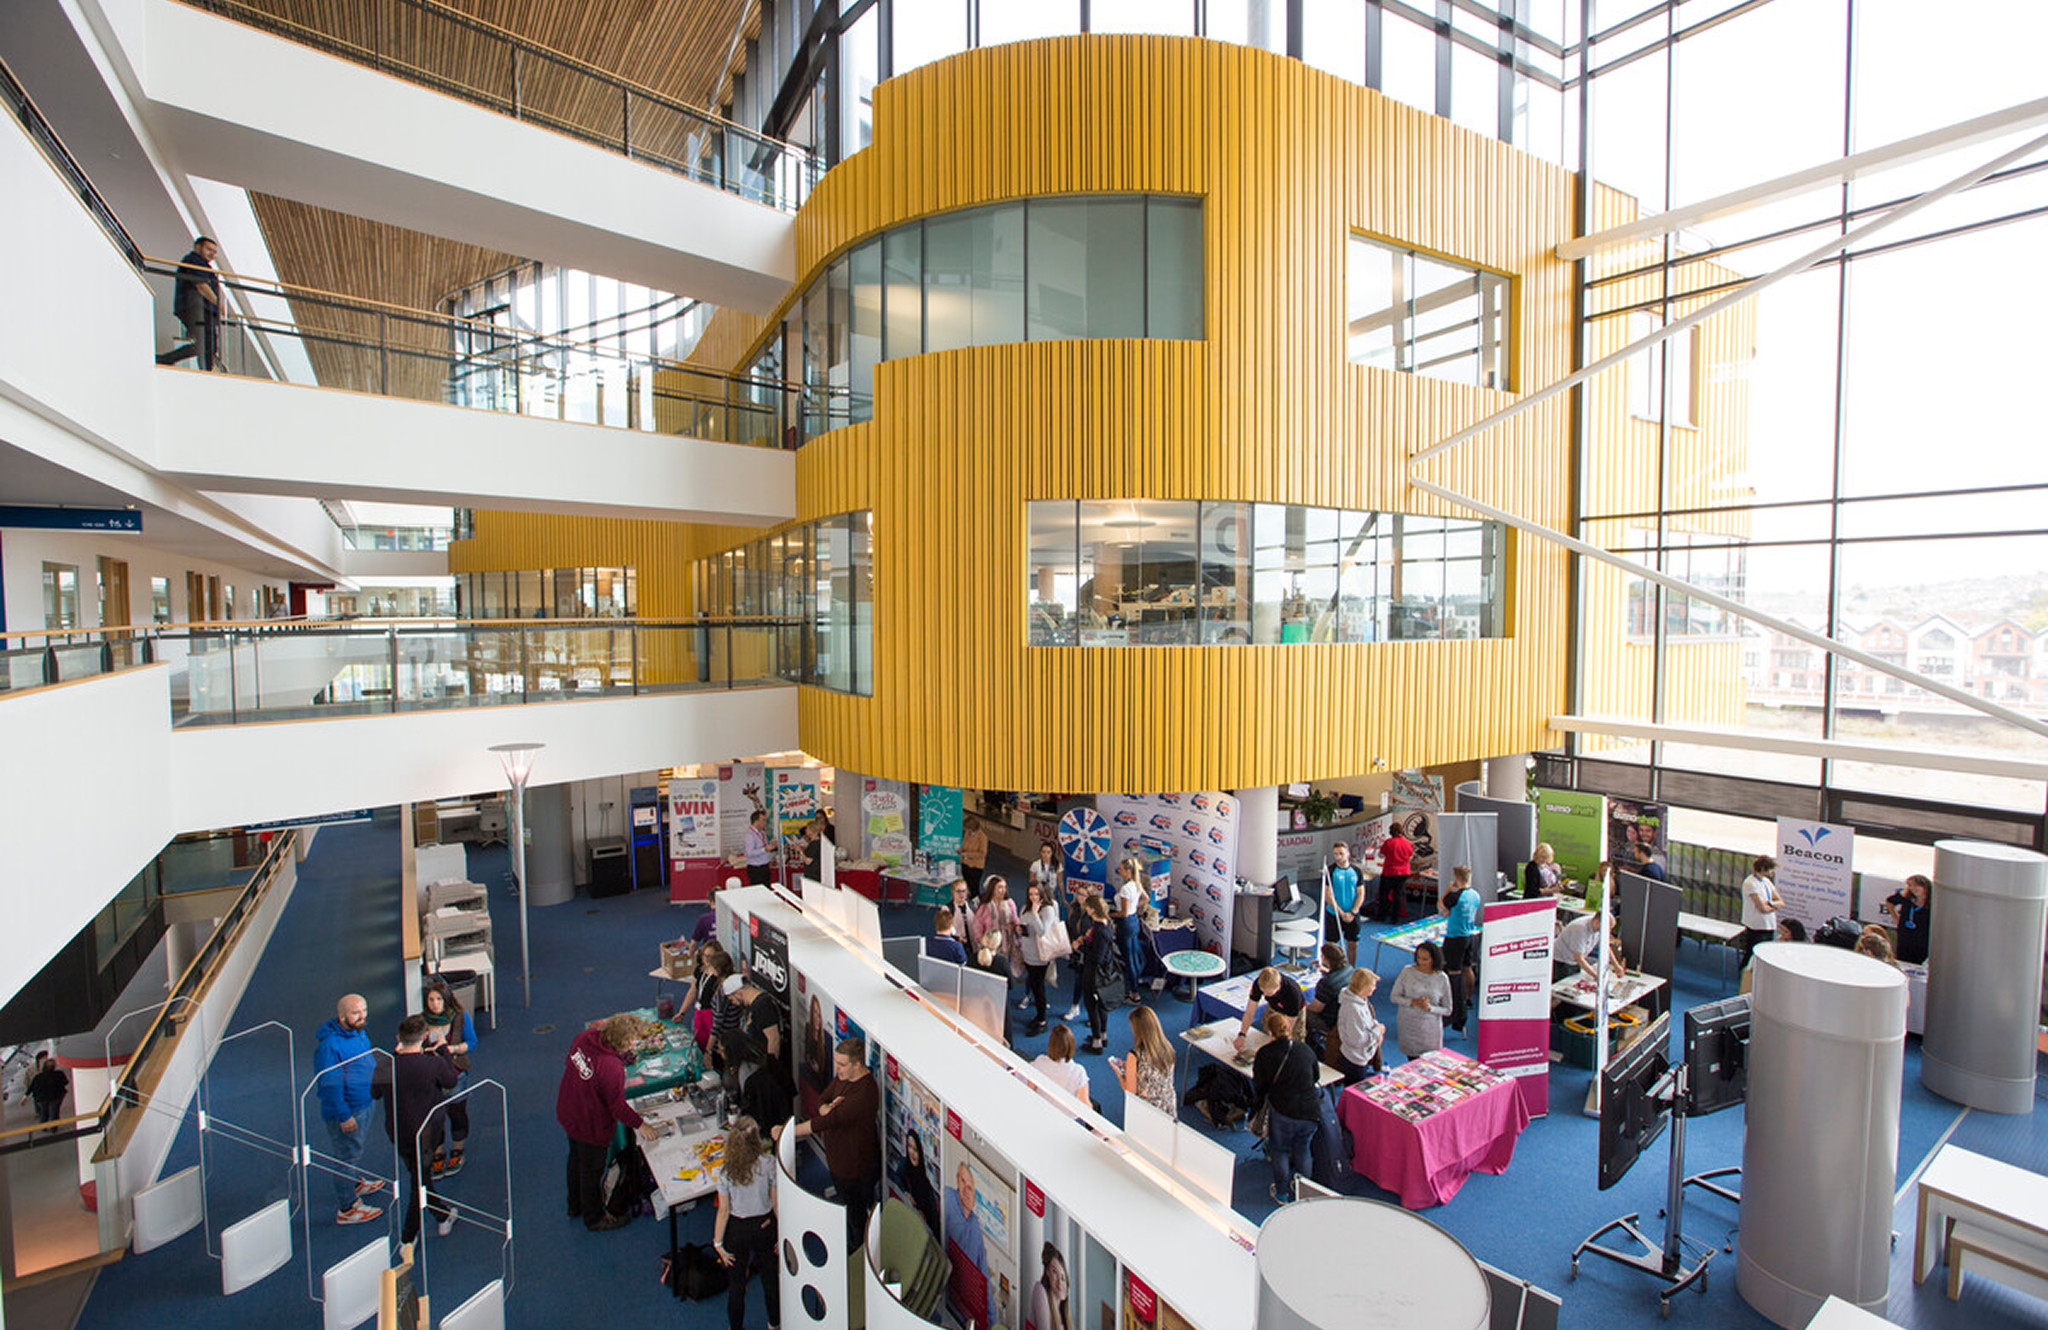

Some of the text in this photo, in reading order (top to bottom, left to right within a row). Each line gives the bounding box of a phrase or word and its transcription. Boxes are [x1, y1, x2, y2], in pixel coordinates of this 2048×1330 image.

[673, 801, 715, 816] WIN
[1033, 822, 1059, 839] ADV
[1355, 819, 1383, 840] PARTH
[1783, 844, 1844, 864] Beacon
[1491, 938, 1548, 954] time to change
